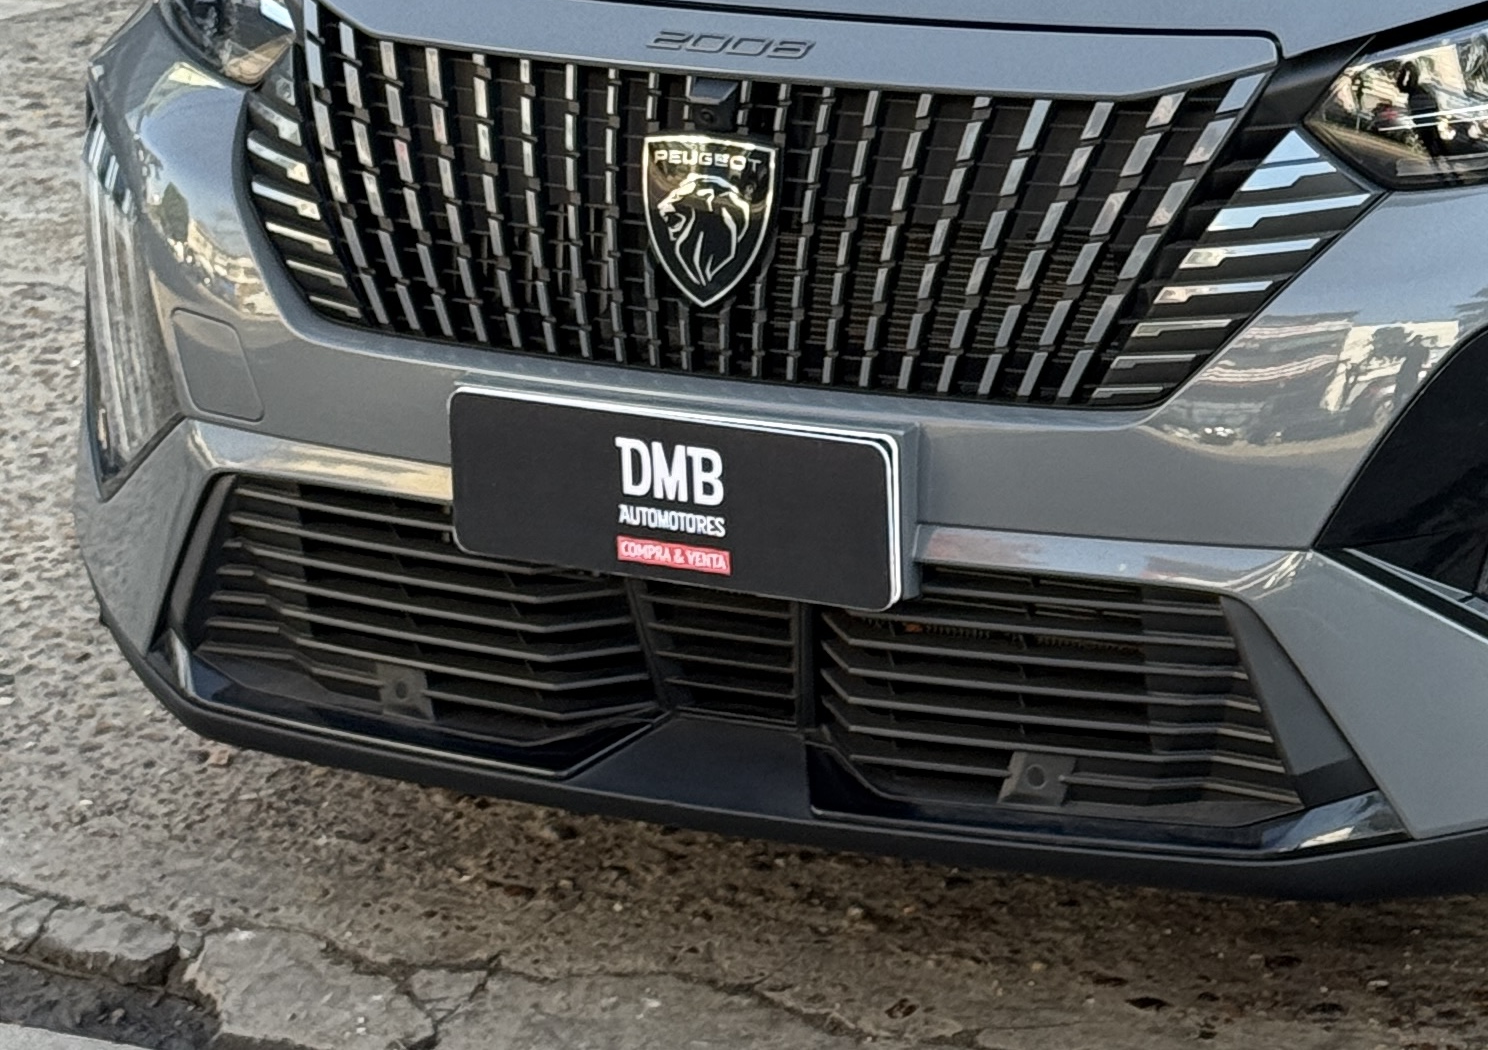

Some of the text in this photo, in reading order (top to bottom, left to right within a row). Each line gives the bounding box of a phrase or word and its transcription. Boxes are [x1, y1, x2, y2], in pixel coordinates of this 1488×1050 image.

[646, 30, 817, 60] 2008
[653, 149, 762, 172] PEUGEOT
[614, 436, 724, 506] DMB
[618, 503, 726, 538] AUTOMOTORES
[621, 540, 727, 570] COMPRA & VENTA
